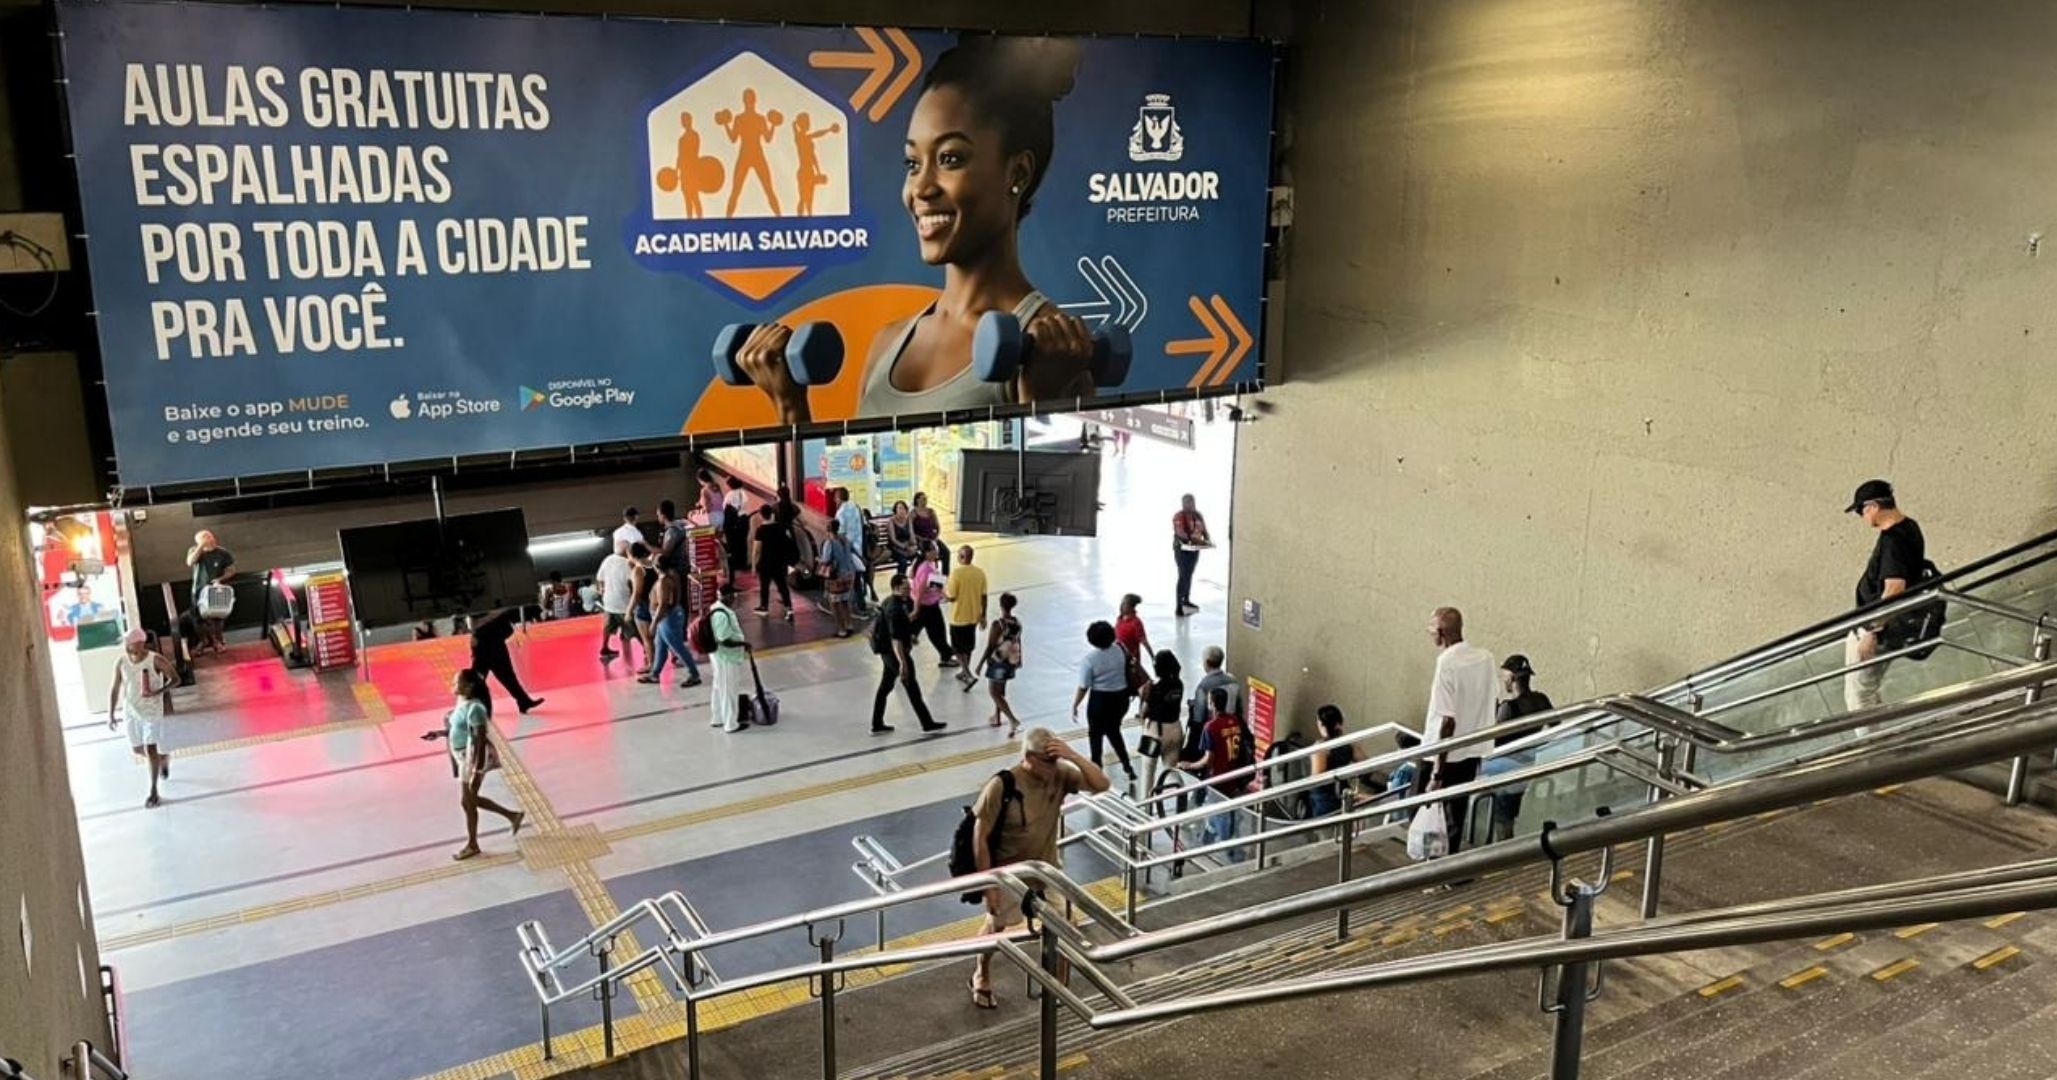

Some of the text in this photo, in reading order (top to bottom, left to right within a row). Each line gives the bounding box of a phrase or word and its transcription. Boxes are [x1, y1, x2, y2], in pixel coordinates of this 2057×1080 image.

[124, 63, 550, 130] AULAS GRATUITAS
[129, 144, 452, 206] ESPALHADAS
[1088, 171, 1219, 203] SALVADOR
[1107, 205, 1200, 223] PREFEITURA
[140, 216, 592, 284] POR TODA A CIDADE
[634, 228, 868, 255] ACADEMIA SALVADOR
[151, 281, 404, 361] PRA VOCÊ.
[417, 390, 461, 401] Baixar na
[548, 378, 613, 391] DISPONÍVEL NO
[549, 387, 636, 409] Google Play
[164, 394, 350, 422] Baixe o app MUDE
[417, 398, 501, 420] App Store
[167, 412, 370, 444] e agende seu treino.
